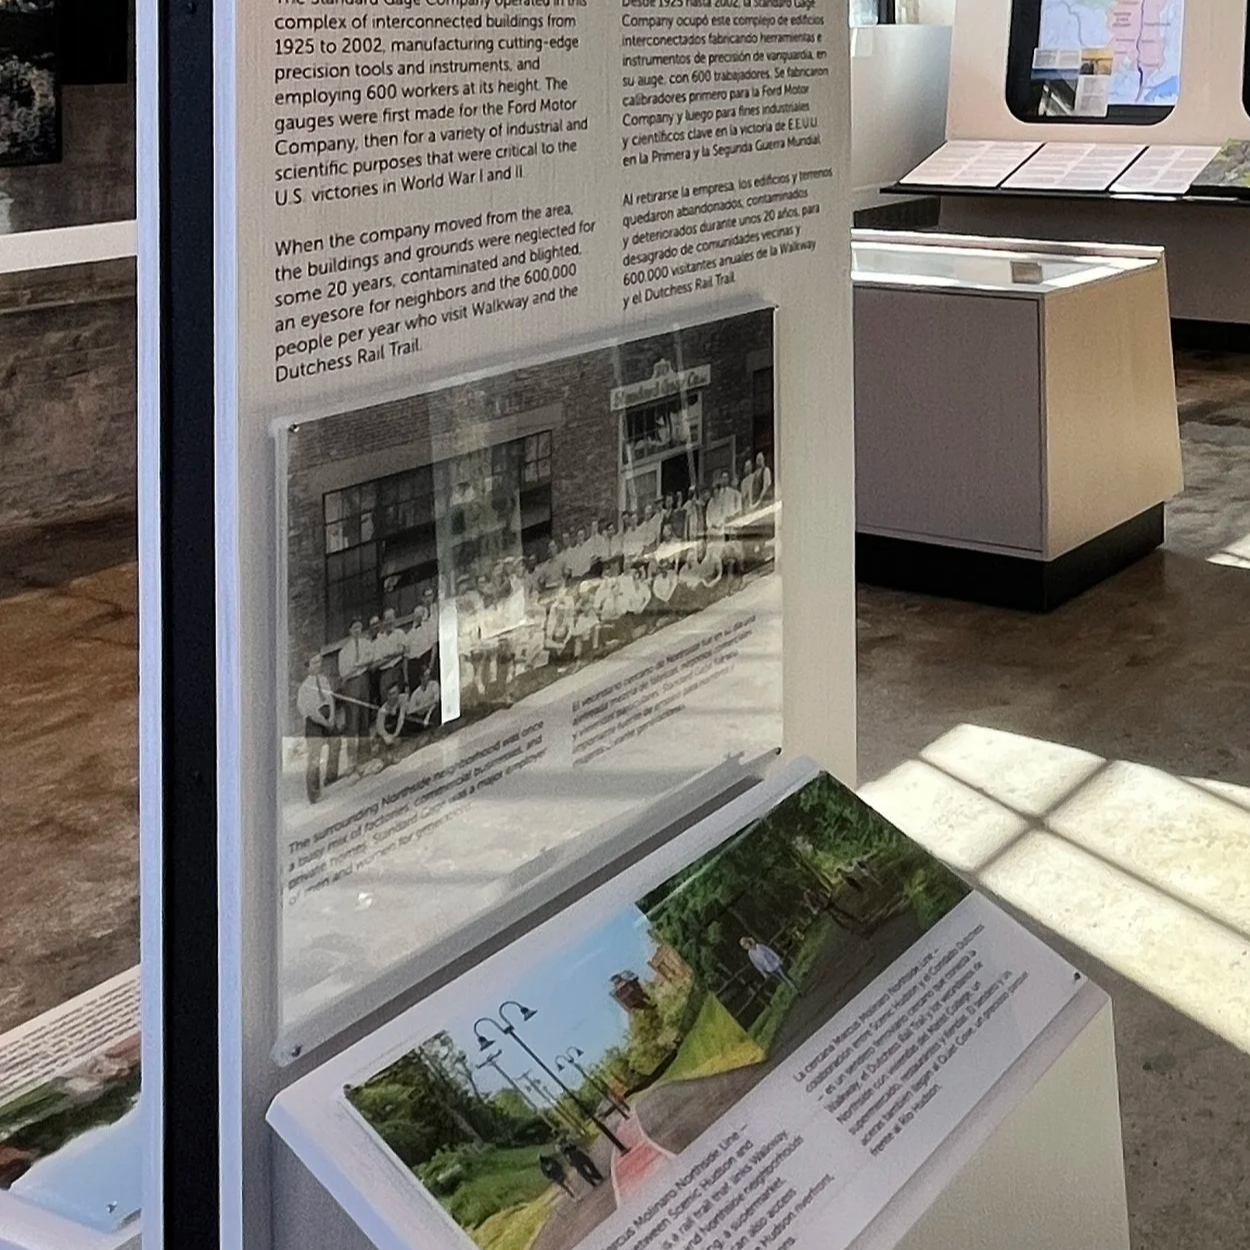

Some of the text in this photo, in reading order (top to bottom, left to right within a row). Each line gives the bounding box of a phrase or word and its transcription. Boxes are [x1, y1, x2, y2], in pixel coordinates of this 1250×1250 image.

[274, 13, 576, 32] complex of interconnected buildings from
[275, 37, 314, 55] 1925
[320, 39, 337, 54] to
[391, 36, 494, 52] manufacturing
[498, 35, 579, 51] cutting-edge
[274, 238, 324, 257] When
[329, 233, 355, 248] the
[359, 224, 430, 244] company
[434, 213, 482, 233] moved
[486, 211, 518, 225] from
[521, 206, 541, 220] the
[275, 219, 596, 282] the buildings and grounds were neglected for
[275, 355, 352, 383] Dutchess
[357, 344, 385, 364] Rail
[288, 834, 310, 854] The
[381, 776, 432, 809] Northside
[633, 1190, 677, 1229] Molinaro
[675, 1150, 721, 1190] Northside
[719, 1131, 741, 1152] Line
[668, 1186, 703, 1220] Scenic
[701, 1156, 736, 1190] Hudson
[735, 1139, 754, 1159] and
[760, 1210, 797, 1248] Hudson
